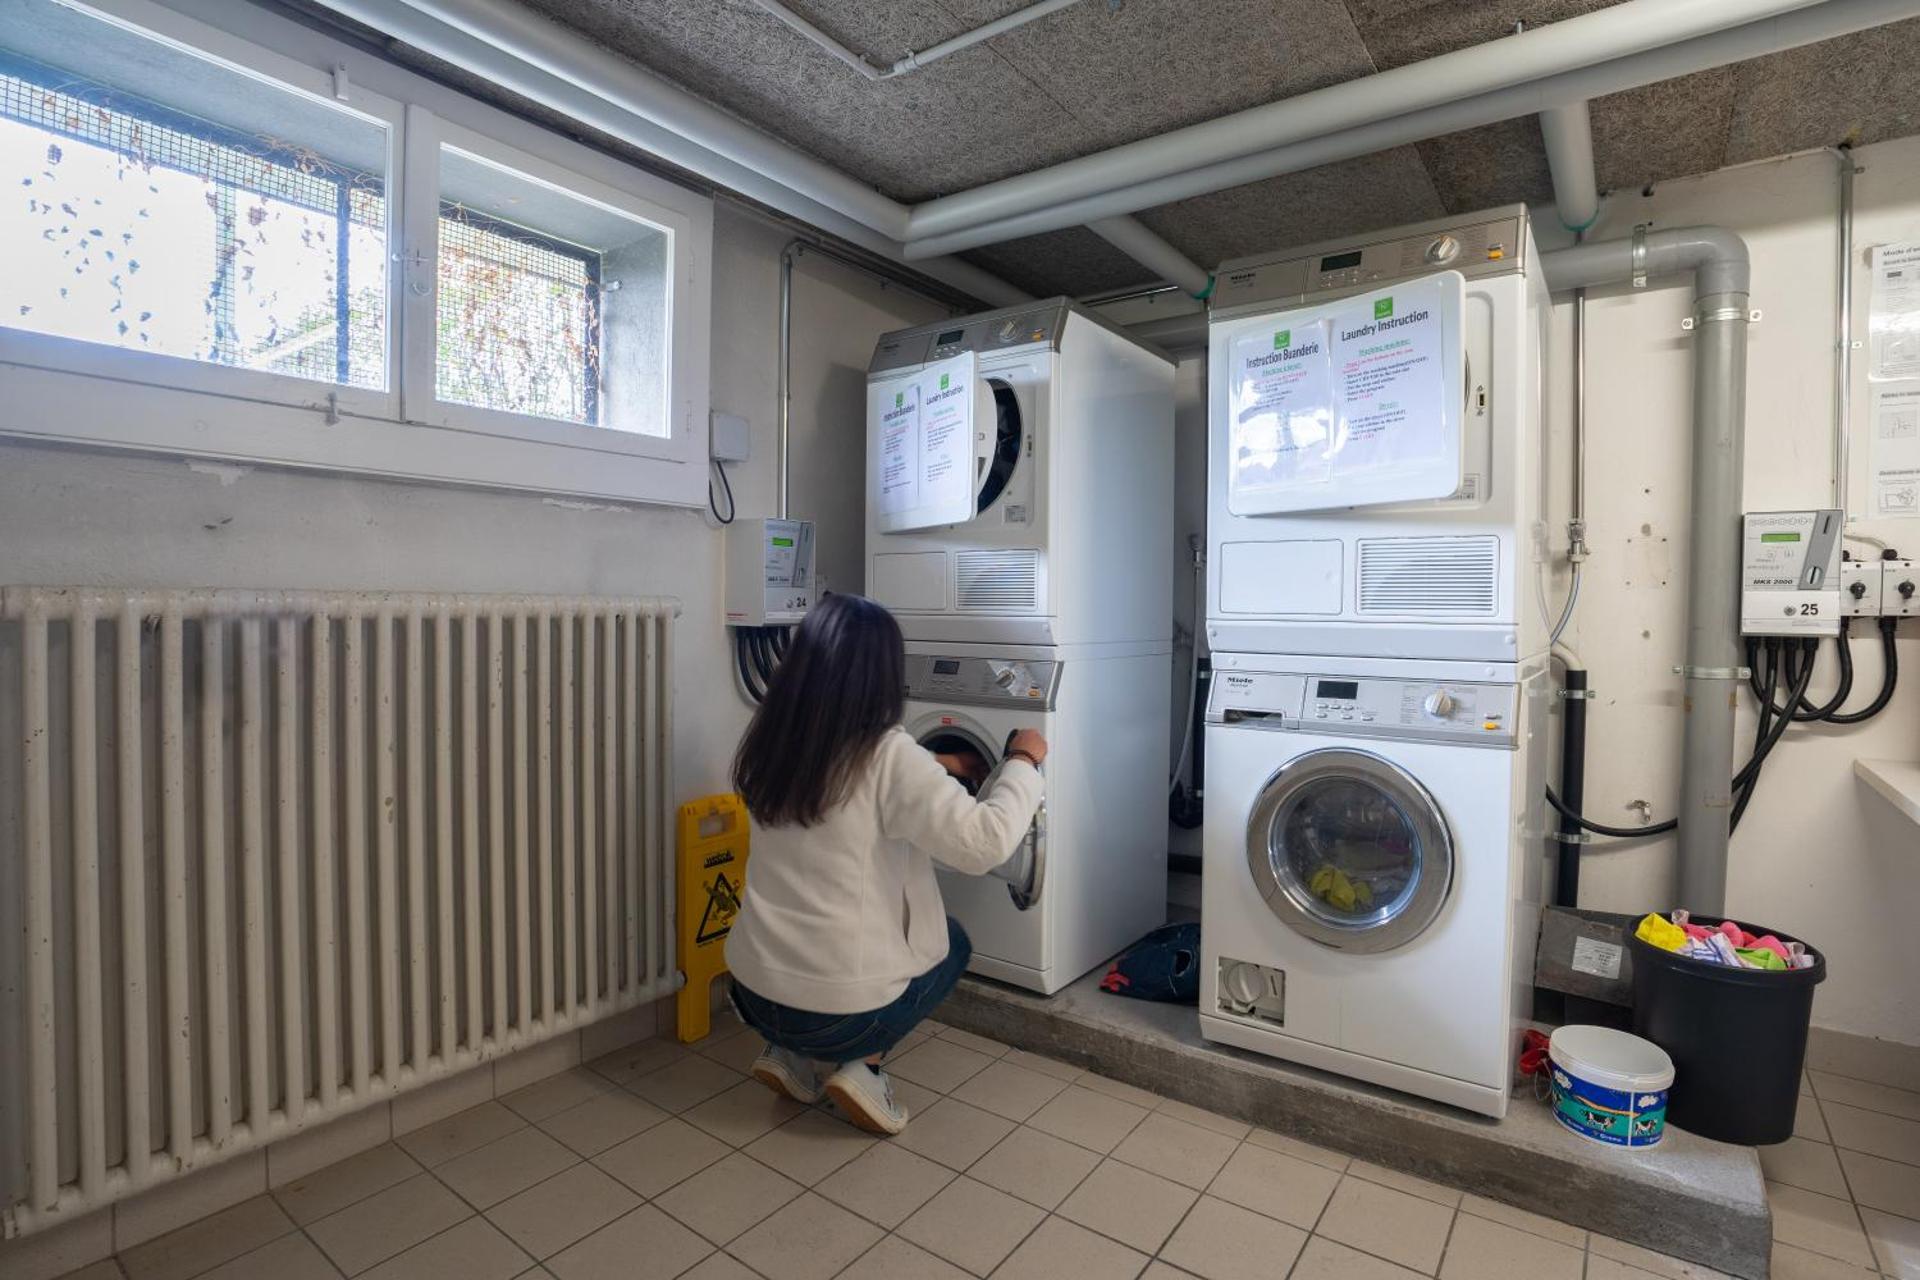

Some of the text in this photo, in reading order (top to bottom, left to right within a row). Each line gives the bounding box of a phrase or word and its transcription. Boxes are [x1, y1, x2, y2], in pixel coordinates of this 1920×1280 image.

[1341, 310, 1429, 341] Laundry Instruction
[1246, 342, 1319, 369] Instruction Buanderie
[1800, 603, 1819, 616] 25
